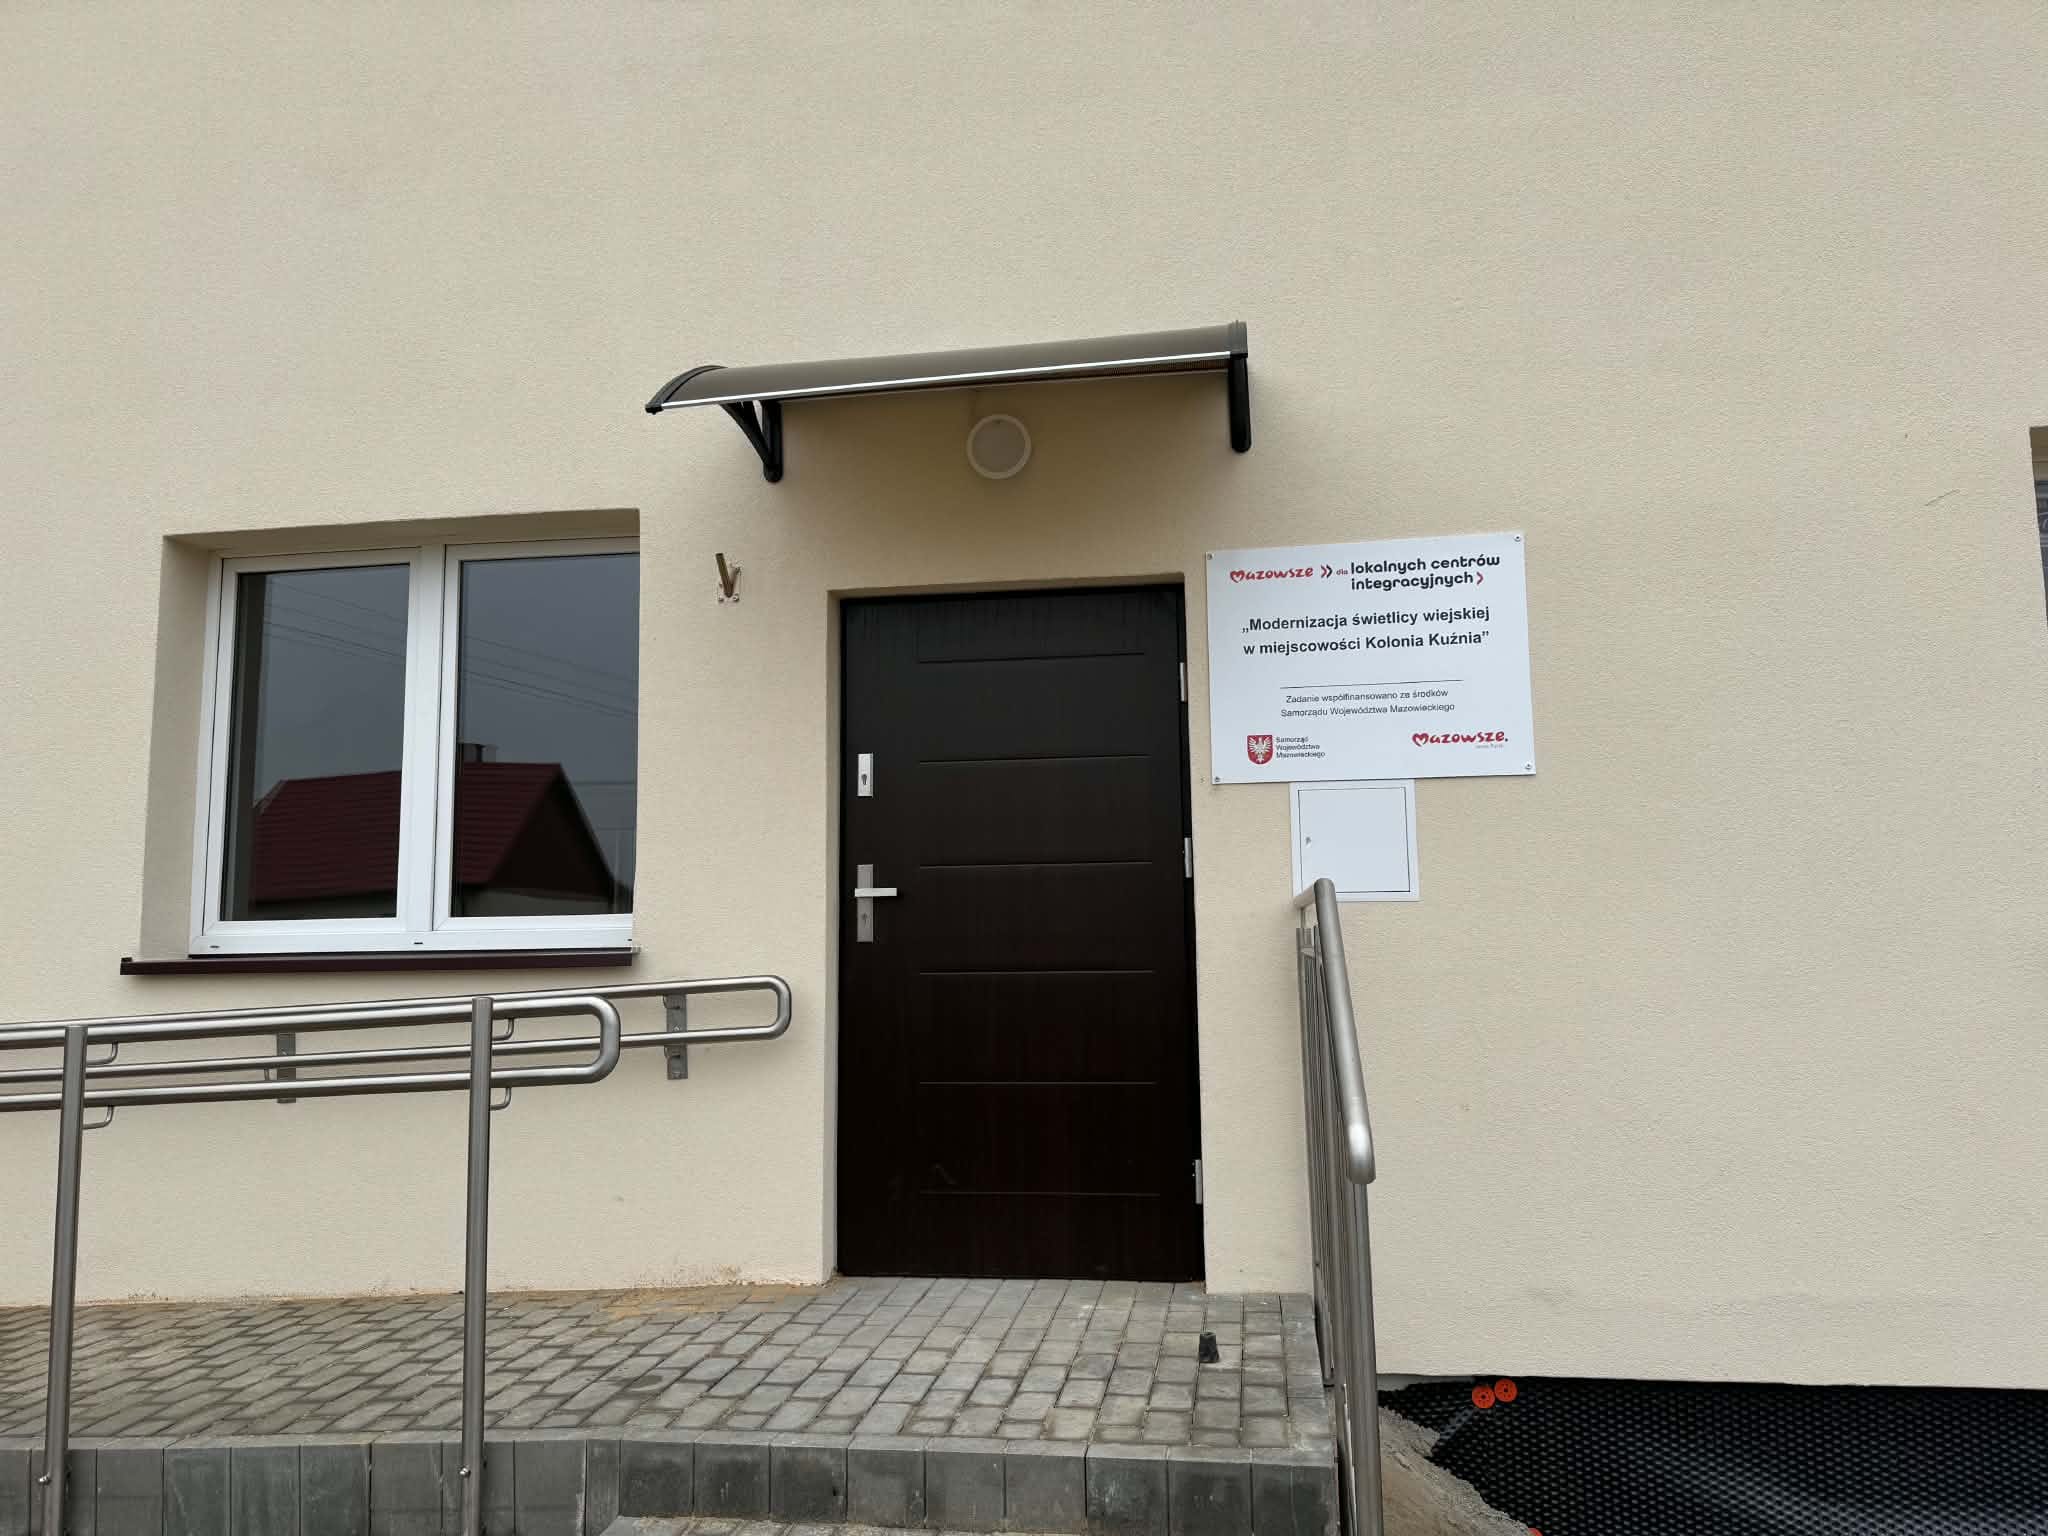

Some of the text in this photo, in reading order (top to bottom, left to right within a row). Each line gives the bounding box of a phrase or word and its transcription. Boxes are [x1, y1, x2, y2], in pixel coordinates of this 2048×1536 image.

[1351, 554, 1501, 575] lokalnych centrów
[1351, 572, 1474, 591] integracyjnych
[1352, 610, 1418, 627] świetlicy
[1423, 606, 1490, 624] wiejskiej
[1243, 644, 1255, 655] w
[1259, 638, 1361, 656] miejscowości
[1366, 635, 1424, 650] Kolonia
[1286, 694, 1320, 704] Zadanie
[1321, 691, 1398, 702] współfinansowano
[1412, 689, 1449, 699] środków
[1281, 702, 1455, 718] Samorządu Województwa Mazowieckiego
[1276, 735, 1309, 745] Samorząd
[1276, 742, 1321, 751] Województwa
